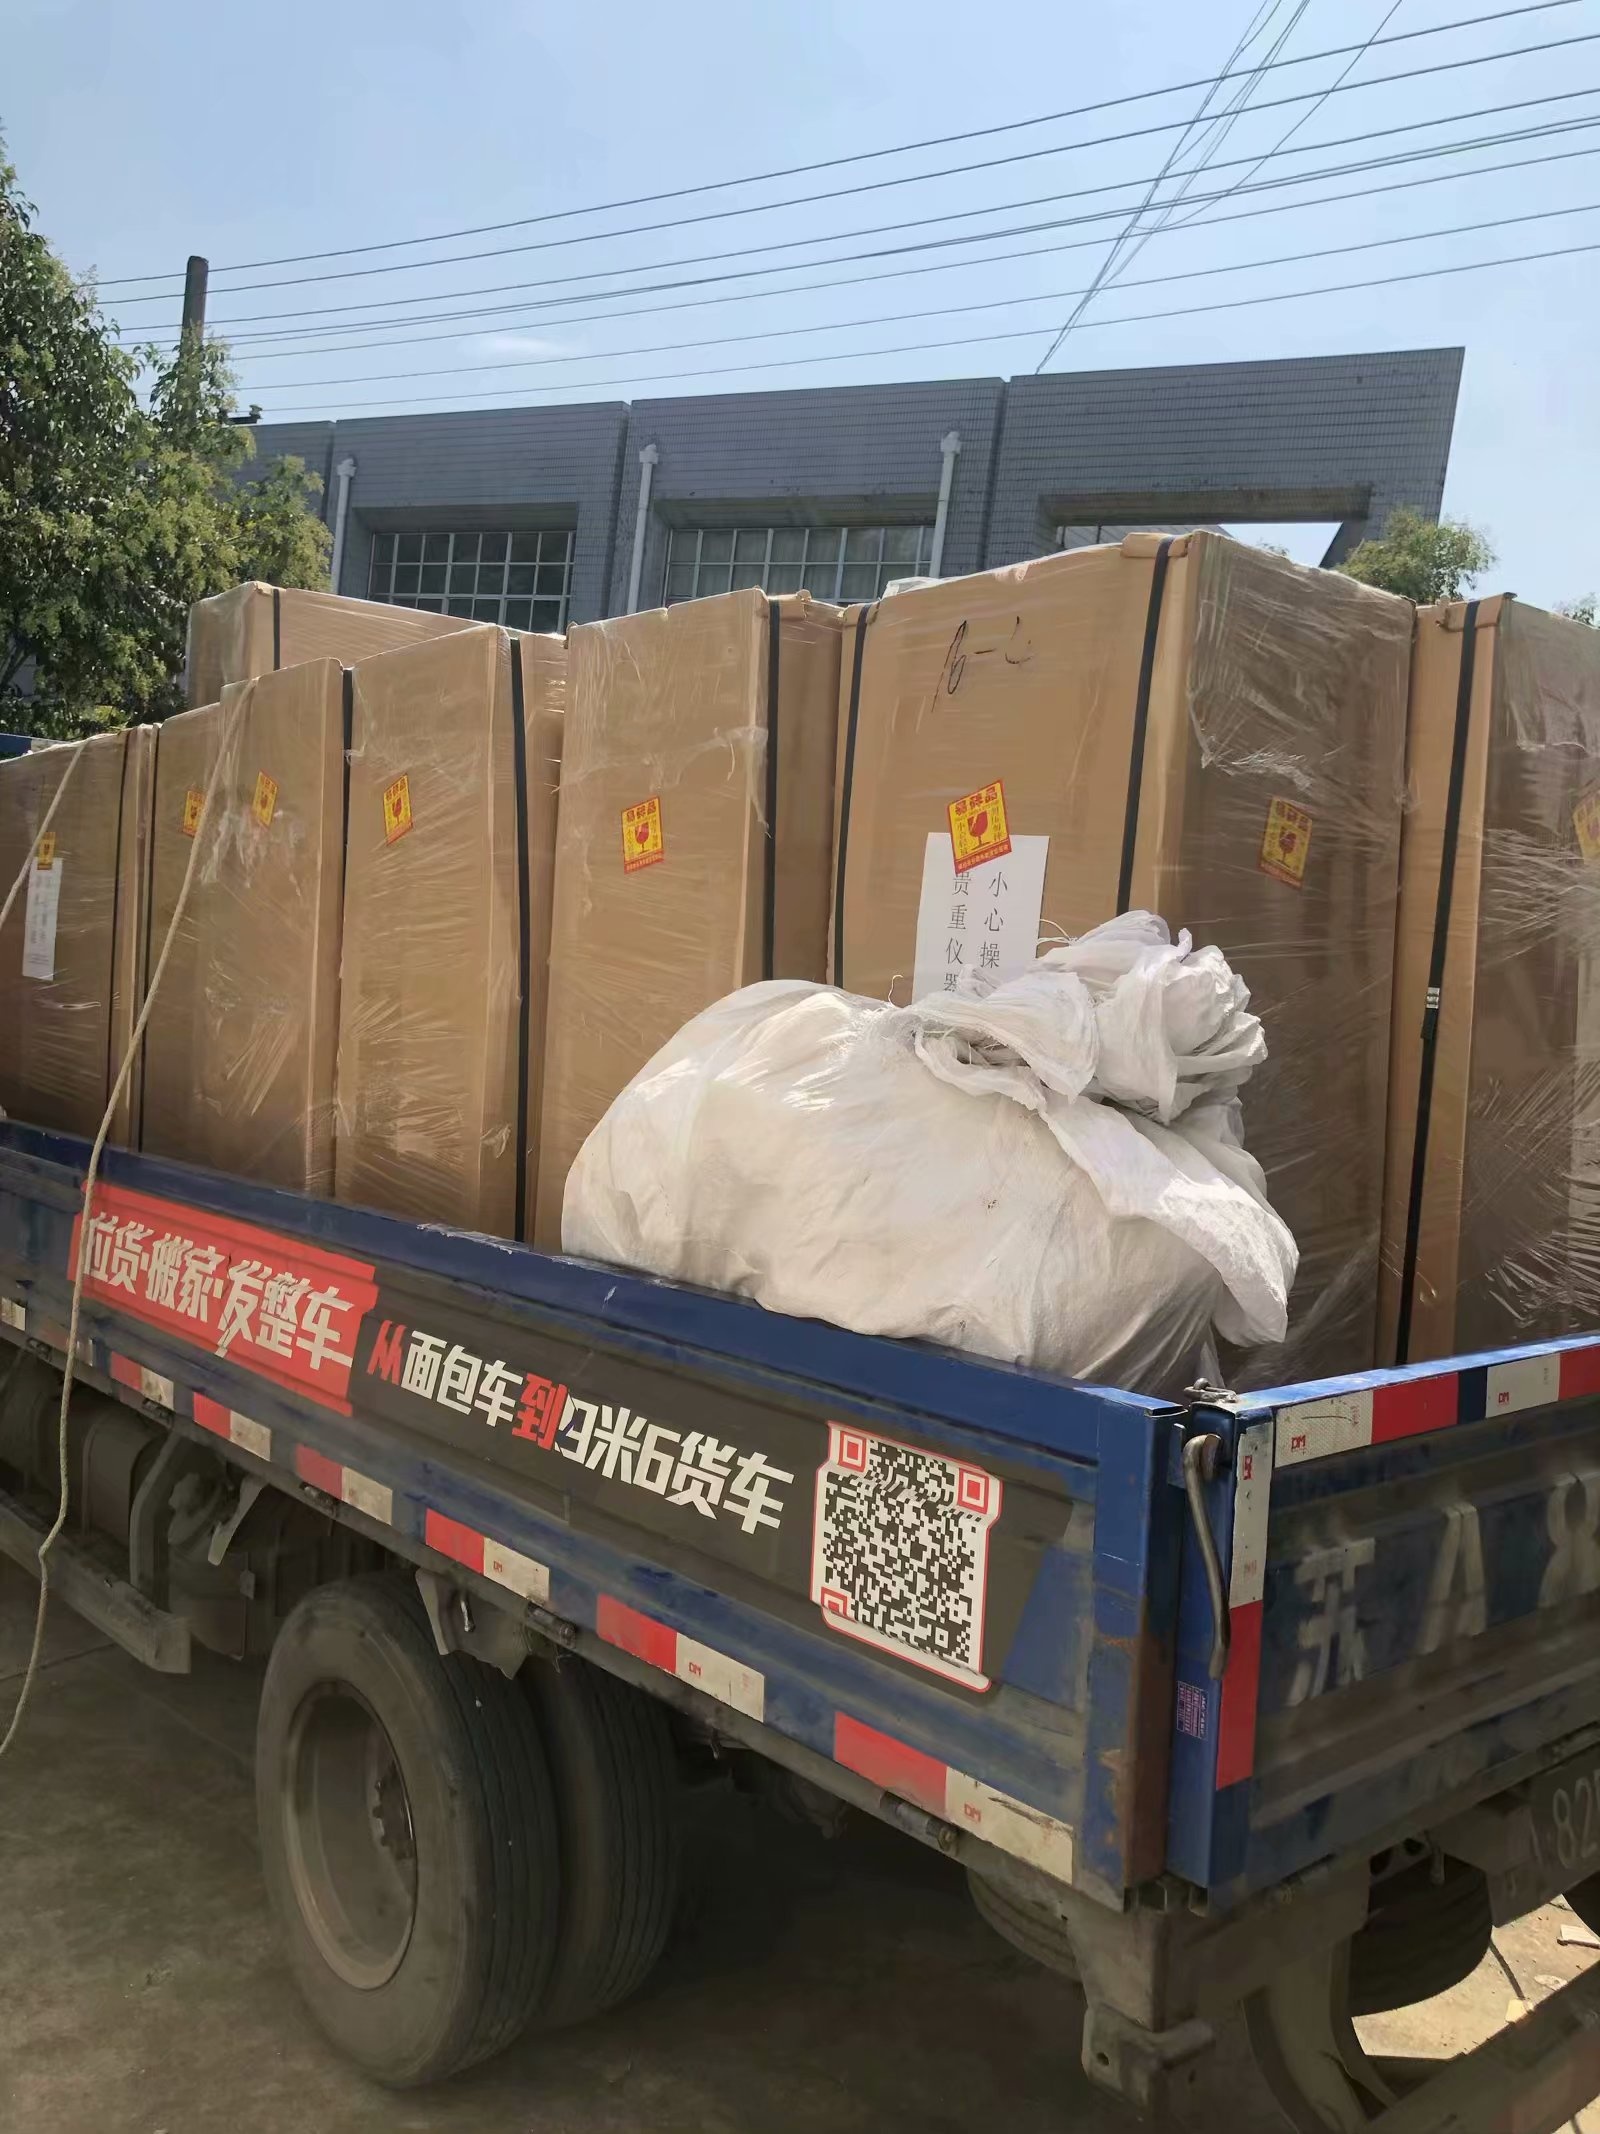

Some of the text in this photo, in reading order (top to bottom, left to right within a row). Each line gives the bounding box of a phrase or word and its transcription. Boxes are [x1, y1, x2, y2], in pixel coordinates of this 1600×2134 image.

[955, 786, 998, 817] 易碎品
[943, 871, 972, 992] 贵重仪器
[979, 871, 1008, 969] 小心操
